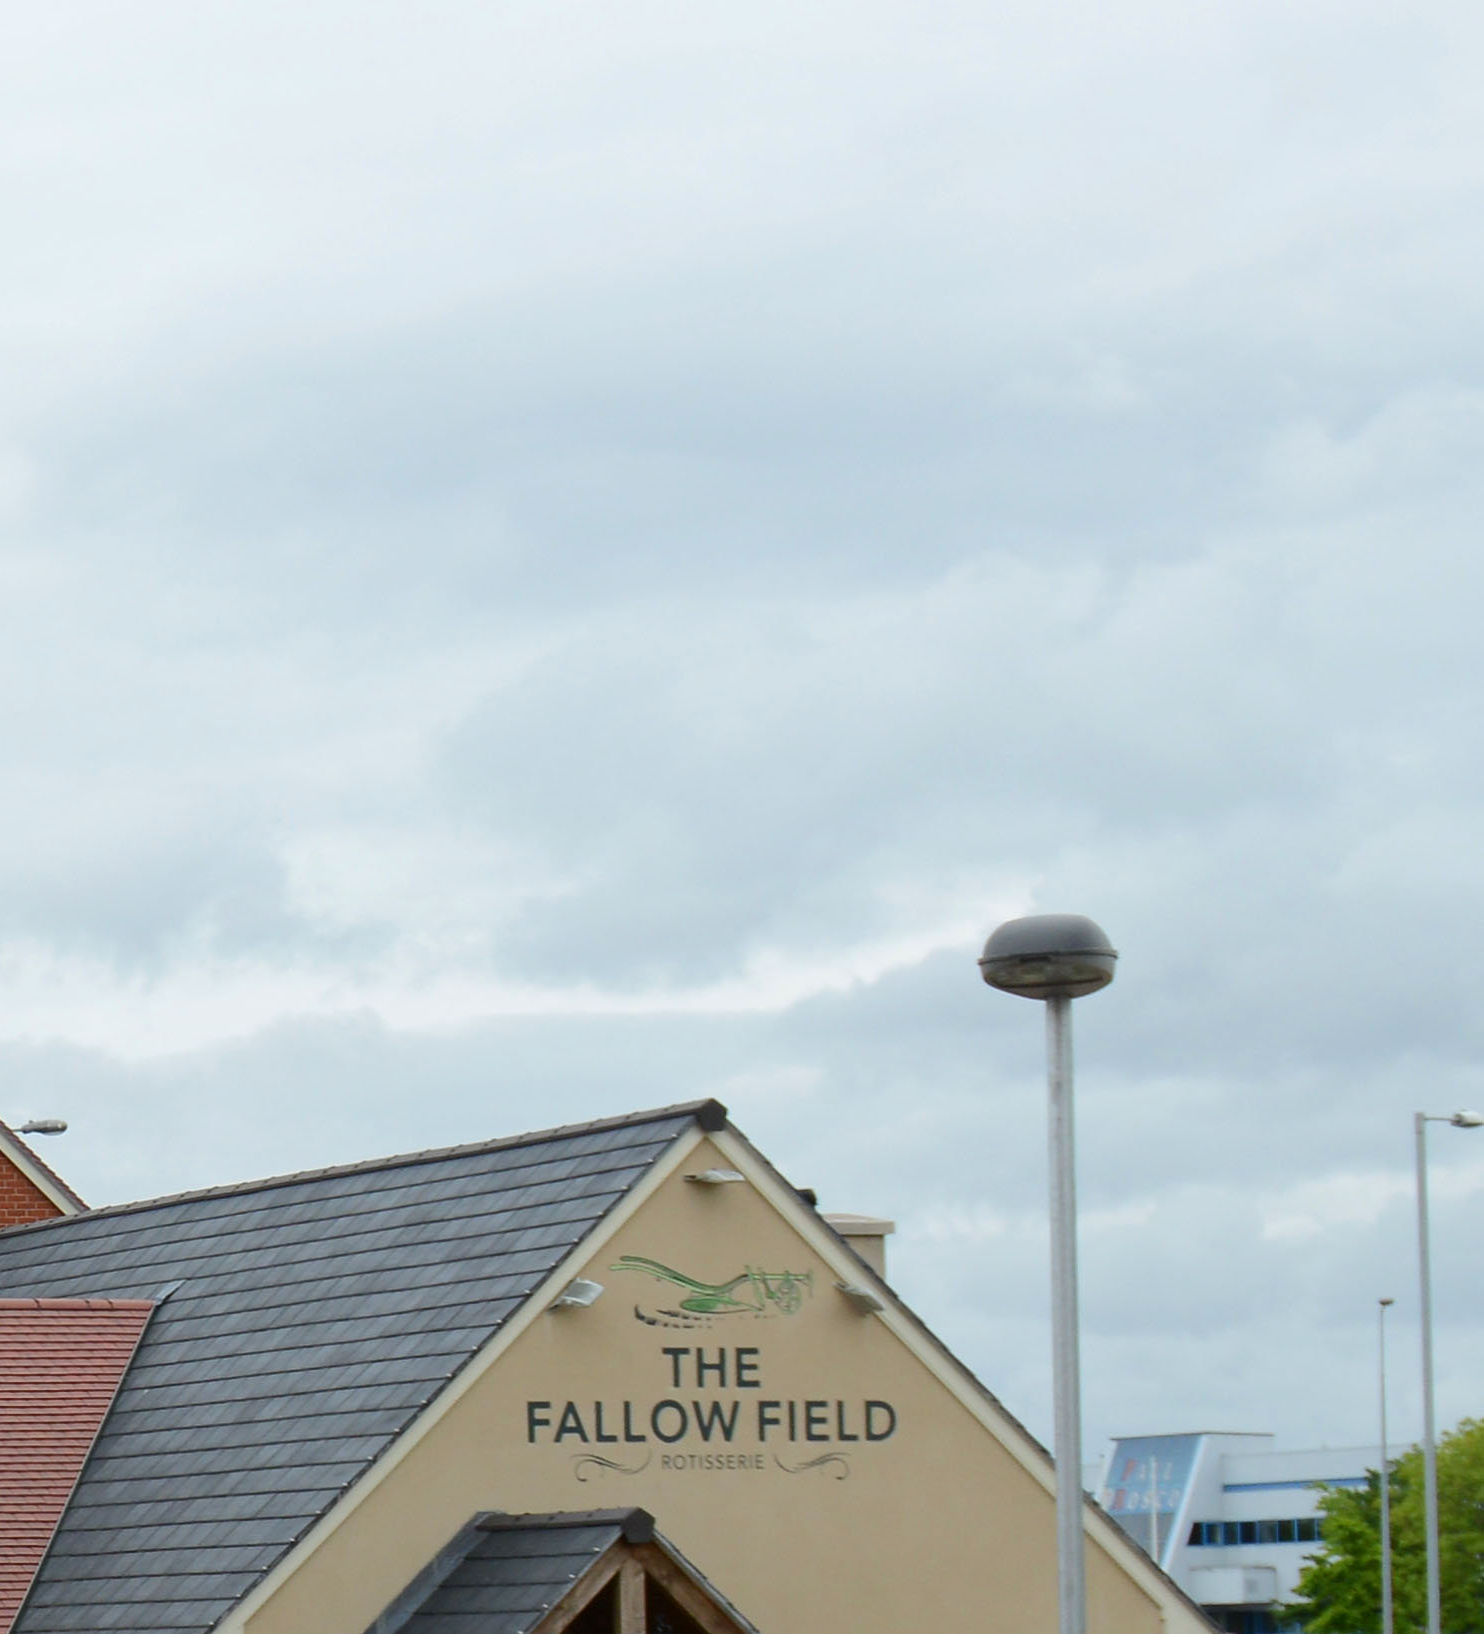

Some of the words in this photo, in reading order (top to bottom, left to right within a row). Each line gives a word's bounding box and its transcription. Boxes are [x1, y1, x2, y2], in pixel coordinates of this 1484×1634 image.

[661, 1346, 761, 1389] THE
[526, 1399, 739, 1444] FALLOW
[758, 1400, 897, 1443] FIELD
[661, 1453, 765, 1471] ROTISSERIE
